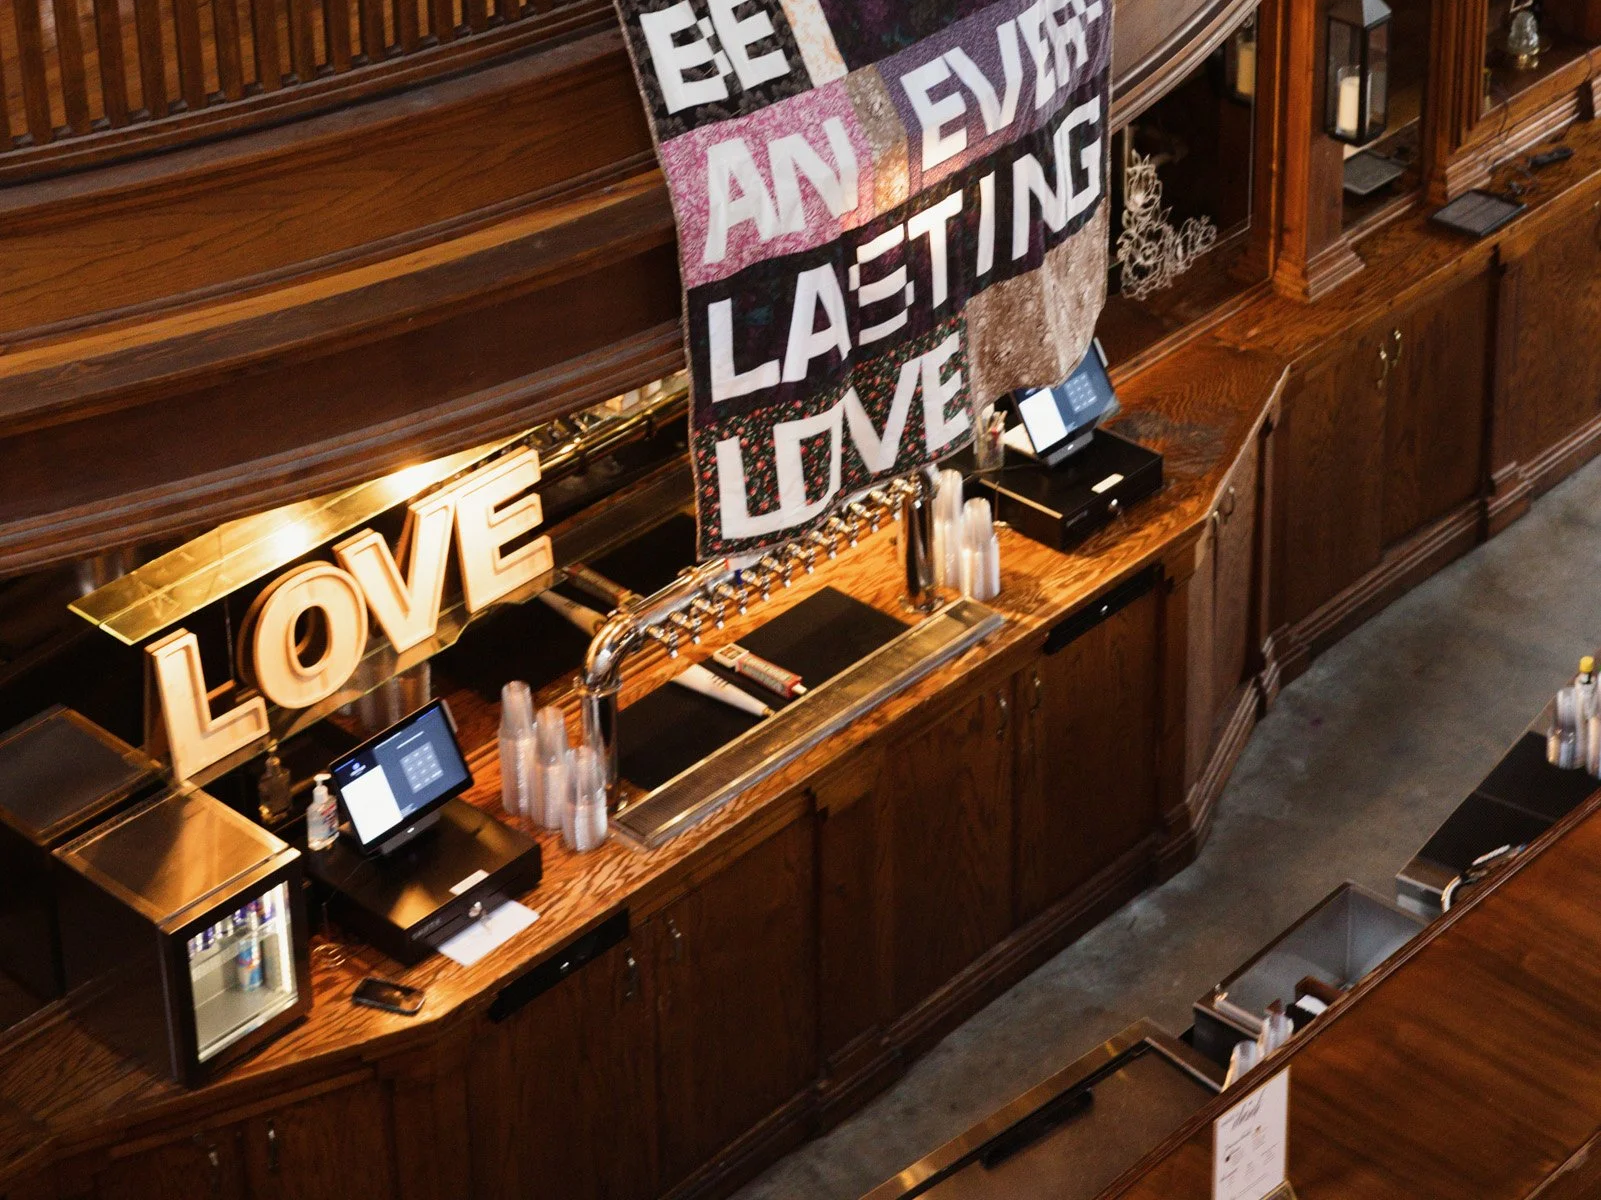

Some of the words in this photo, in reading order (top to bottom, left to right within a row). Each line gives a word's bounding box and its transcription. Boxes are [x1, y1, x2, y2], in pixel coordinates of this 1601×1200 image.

[705, 118, 859, 265] AN
[708, 95, 1100, 402] LASTING
[715, 333, 971, 541] LOVE
[144, 447, 554, 783] LOVE
